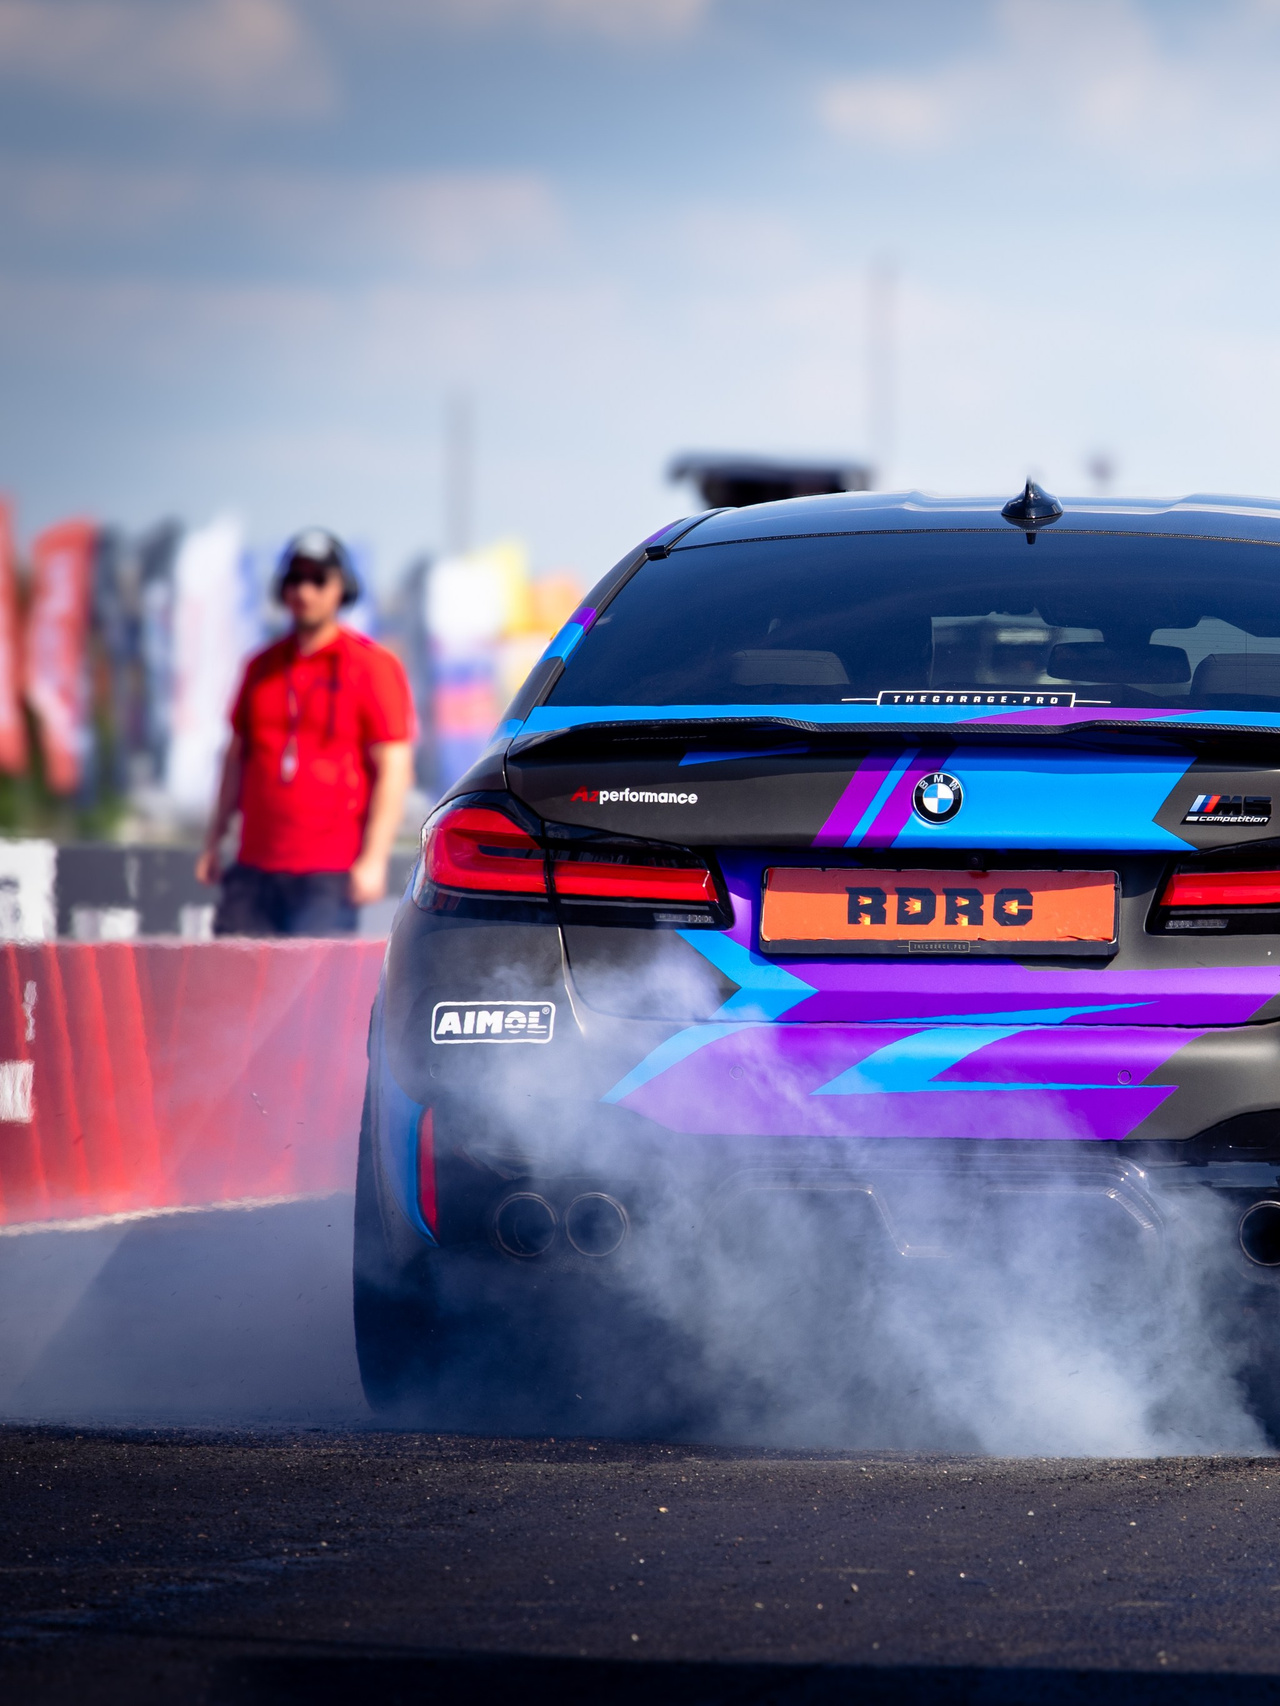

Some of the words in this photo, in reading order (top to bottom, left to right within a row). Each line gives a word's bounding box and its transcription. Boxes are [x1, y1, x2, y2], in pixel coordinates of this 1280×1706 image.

[893, 694, 1060, 705] THEGARAGE.PRO
[1198, 815, 1269, 823] competition
[845, 886, 1034, 926] RDRC
